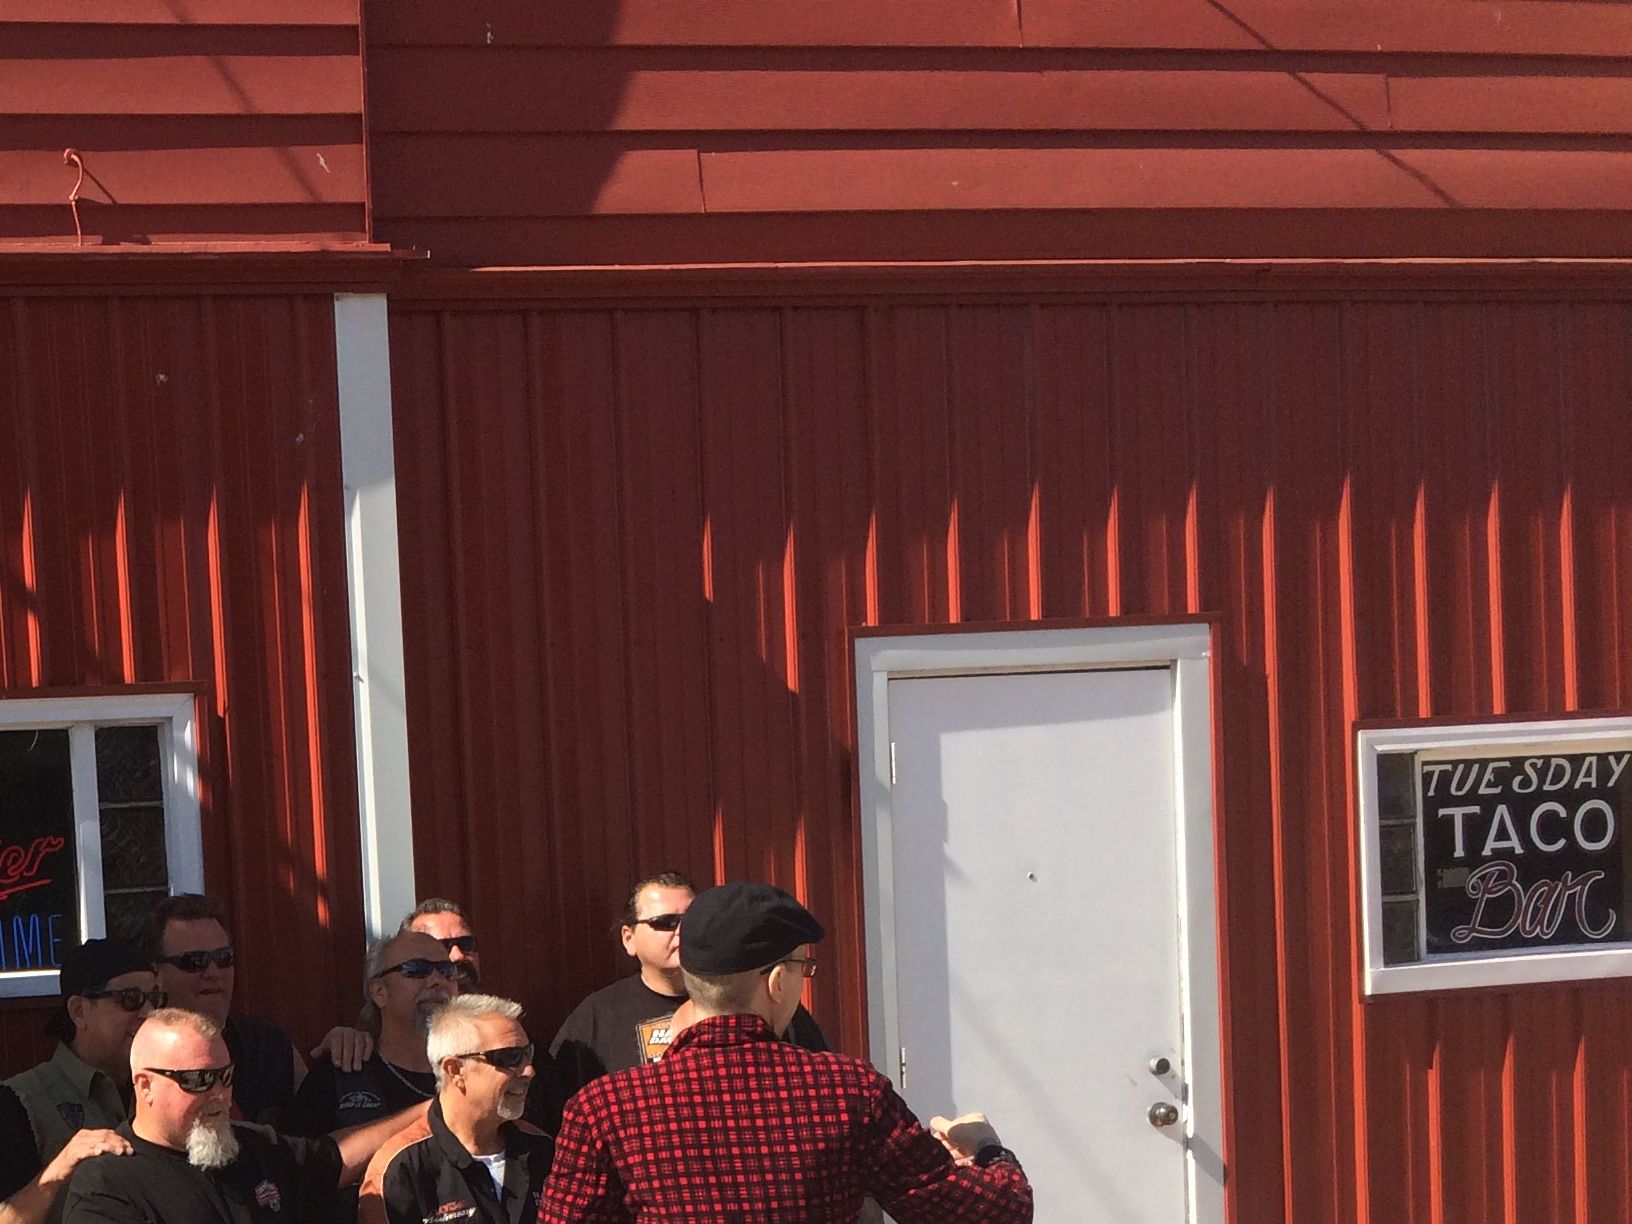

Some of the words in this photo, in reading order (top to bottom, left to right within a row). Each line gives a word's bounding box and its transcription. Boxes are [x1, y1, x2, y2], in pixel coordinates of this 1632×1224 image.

[1423, 754, 1632, 797] TUESDAY
[1438, 799, 1615, 858] TACO
[1450, 860, 1616, 944] Bar
